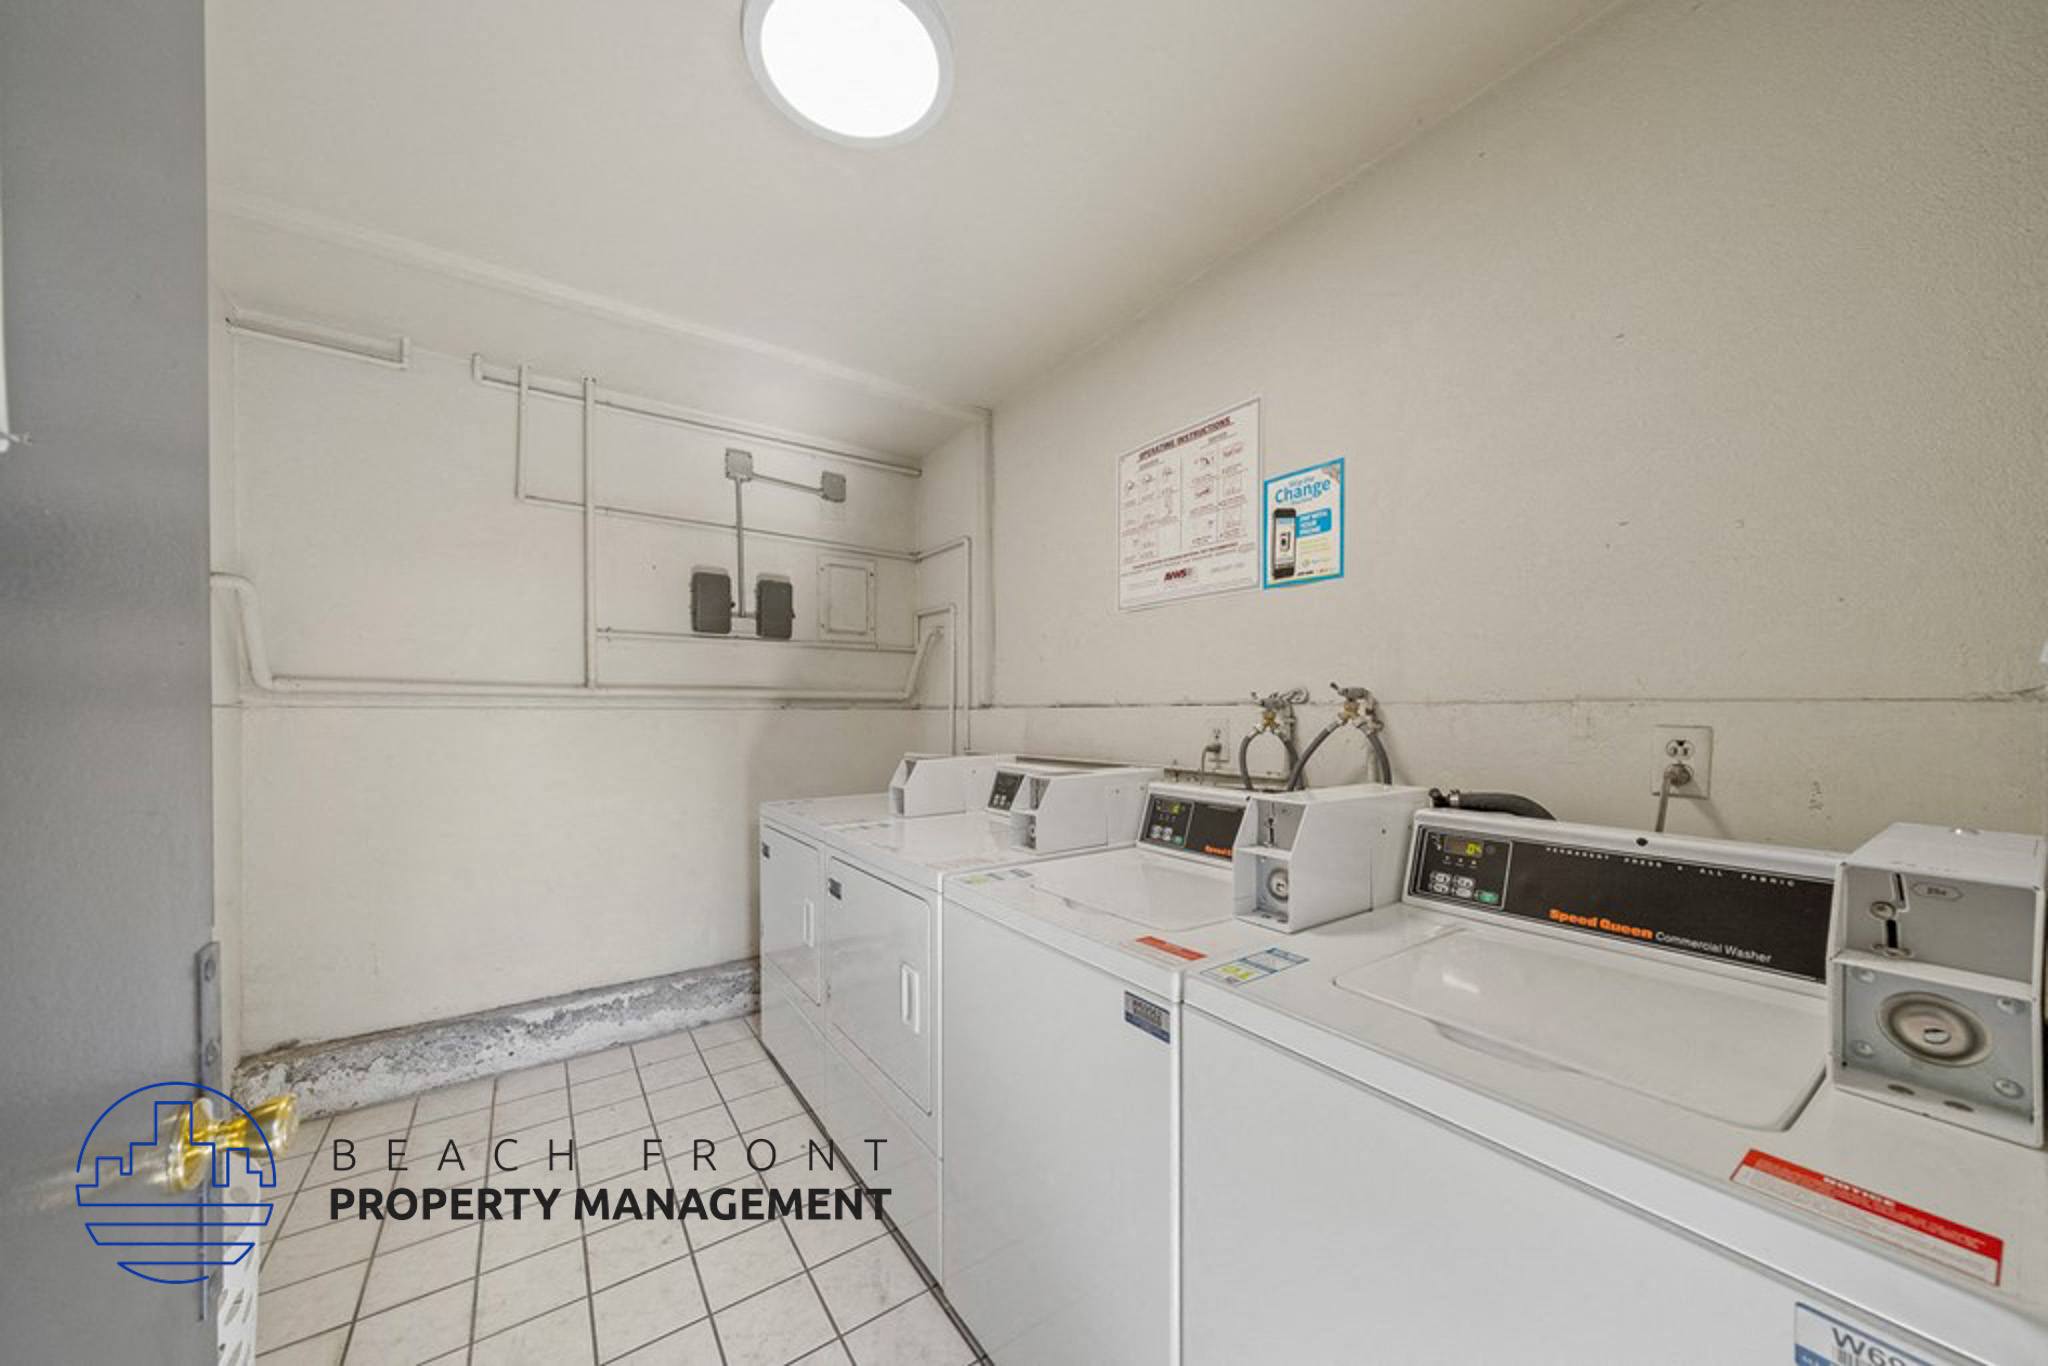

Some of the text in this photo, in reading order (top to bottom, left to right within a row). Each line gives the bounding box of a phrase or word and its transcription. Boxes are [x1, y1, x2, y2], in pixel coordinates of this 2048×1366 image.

[1275, 478, 1331, 504] Change
[1549, 908, 1773, 964] Speed Queen Commercial Washer
